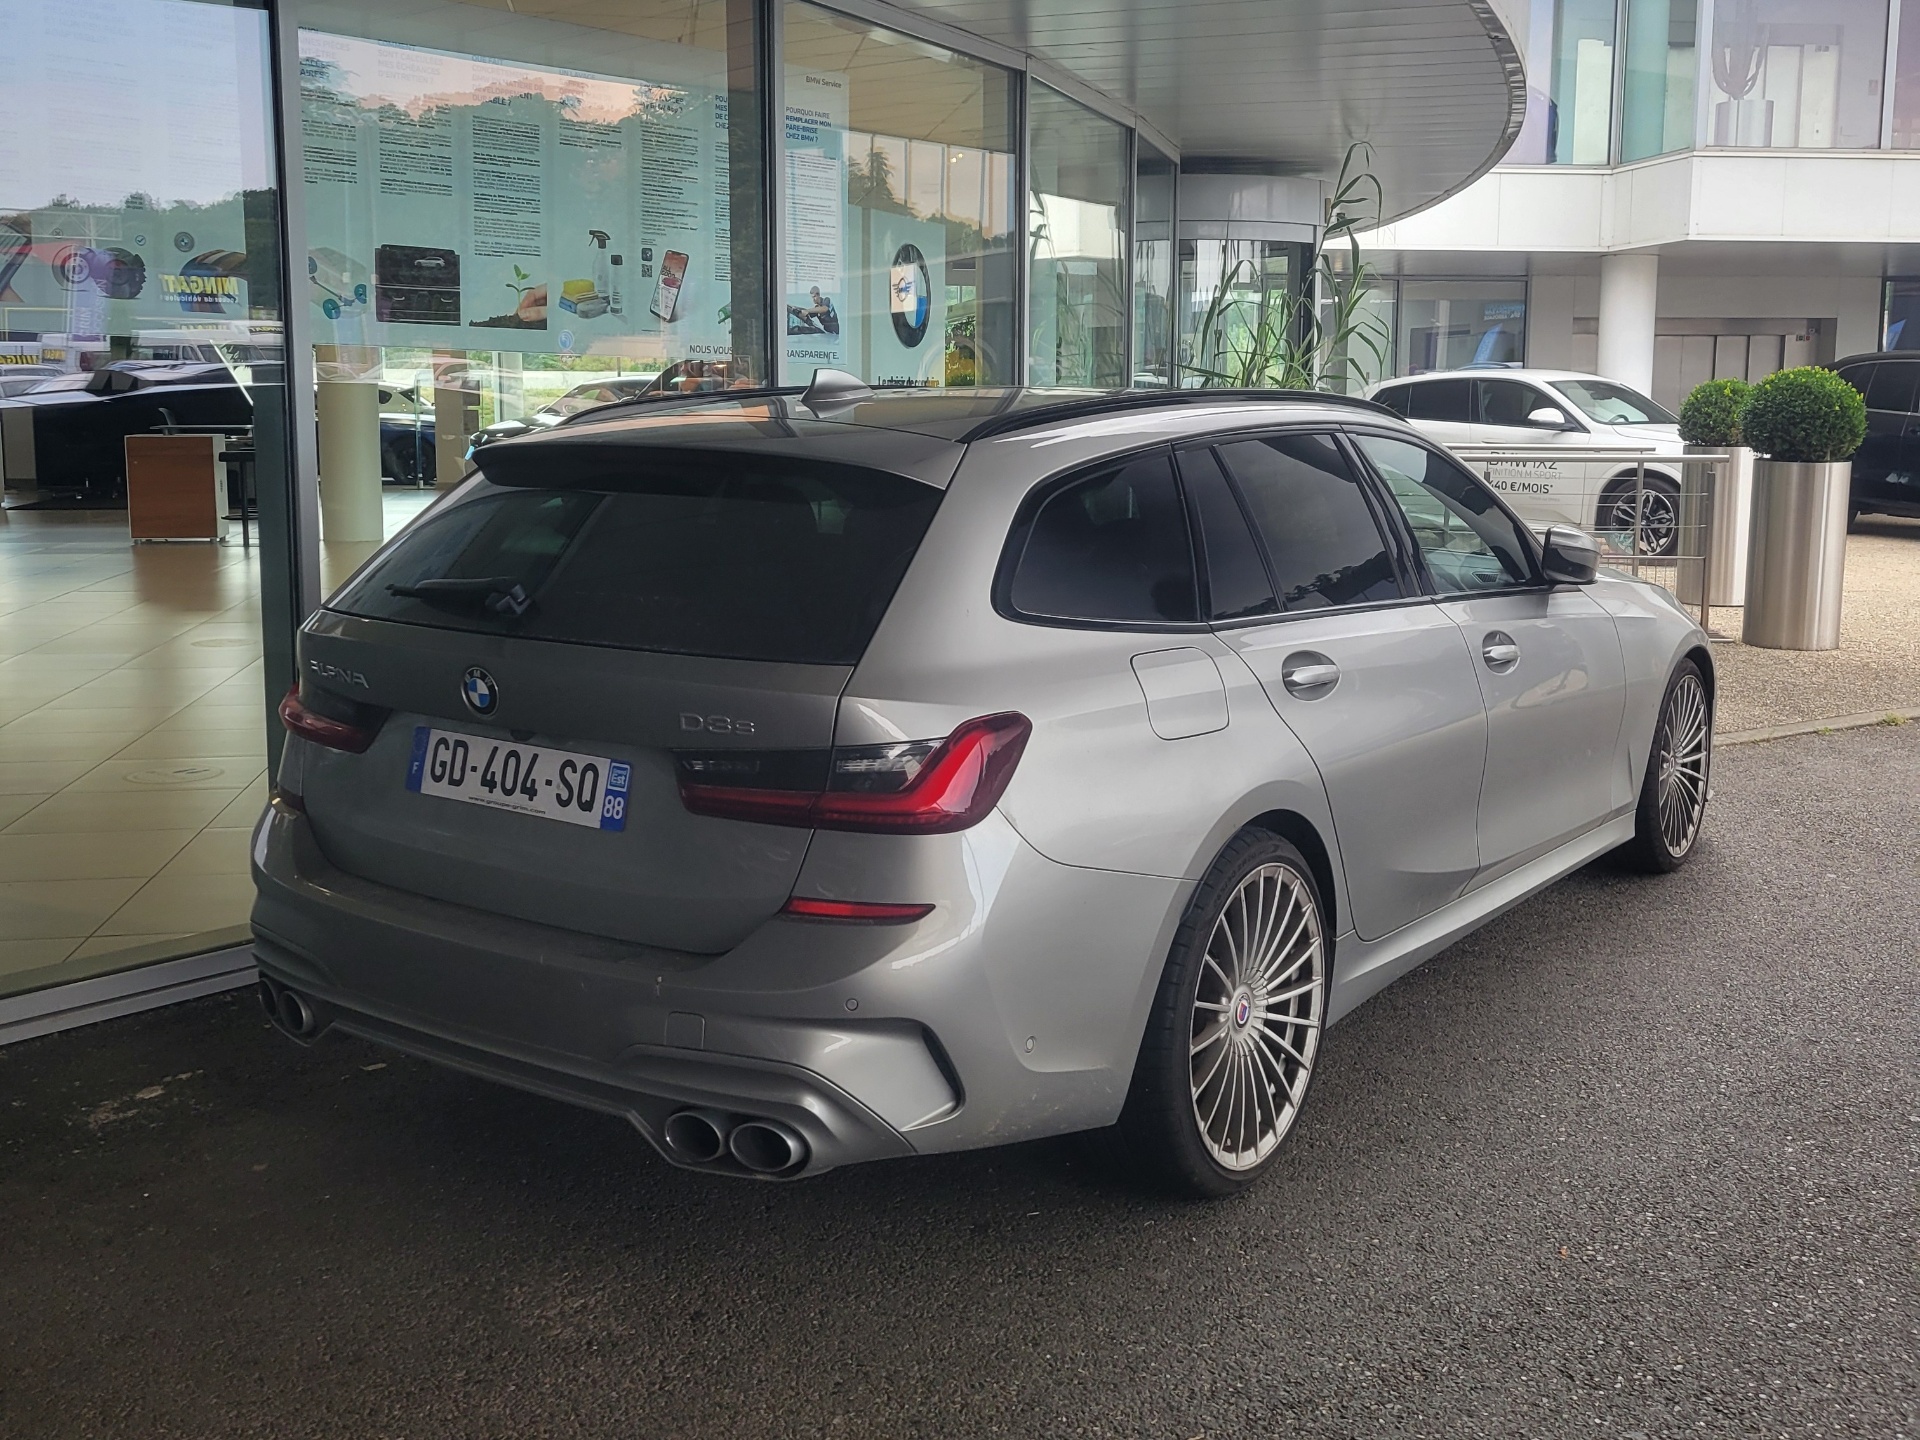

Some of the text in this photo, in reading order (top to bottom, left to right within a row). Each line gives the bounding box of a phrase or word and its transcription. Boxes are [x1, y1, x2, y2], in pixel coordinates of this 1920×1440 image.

[806, 75, 842, 88] BMW Service
[785, 106, 830, 119] POURQUOI FAIRE
[785, 115, 832, 128] REMPLACER MON
[785, 123, 818, 134] PARE-BRISE
[785, 132, 800, 140] CHEZ
[690, 344, 733, 354] NOUS VOUS
[1524, 469, 1532, 478] M
[1534, 470, 1563, 480] SPORT
[412, 761, 420, 774] F
[430, 736, 600, 813] GD-404-SQ
[468, 795, 546, 815] www.groupe-grim.com
[603, 795, 625, 820] 88
